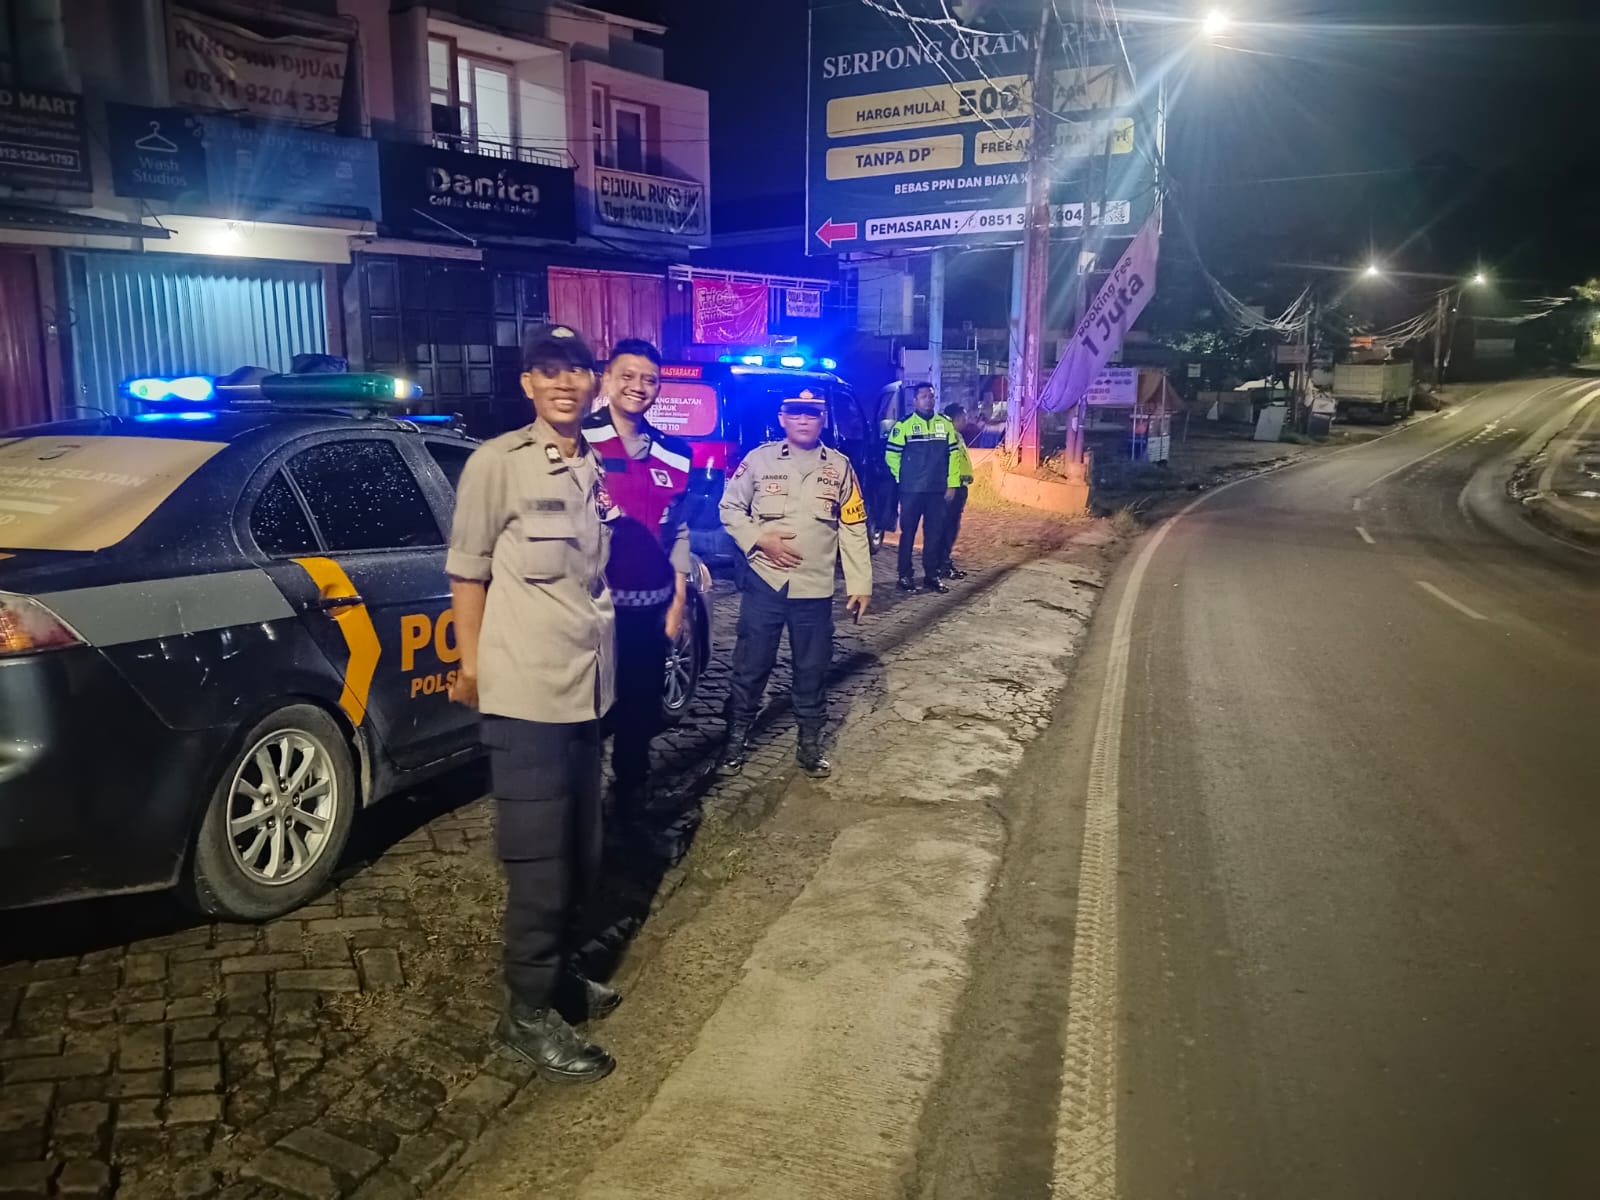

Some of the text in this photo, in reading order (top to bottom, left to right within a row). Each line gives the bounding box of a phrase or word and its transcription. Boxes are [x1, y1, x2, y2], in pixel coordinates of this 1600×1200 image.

[281, 54, 345, 81] DIJUAL
[823, 40, 943, 79] SERPONG
[19, 91, 77, 116] MART
[856, 107, 900, 122] HARGA
[903, 100, 945, 116] MULAI
[138, 156, 180, 172] Wash
[856, 153, 905, 168] TANPA
[981, 141, 1013, 154] FREE
[132, 169, 187, 186] Studios
[430, 167, 540, 203] Danica
[894, 181, 930, 195] BEBAS
[931, 178, 955, 191] PPN
[957, 176, 982, 190] DAN
[984, 173, 1019, 187] BIAYA
[870, 219, 951, 236] PEMASARAN
[1114, 256, 1132, 282] Fee
[1096, 273, 1144, 342] Juta
